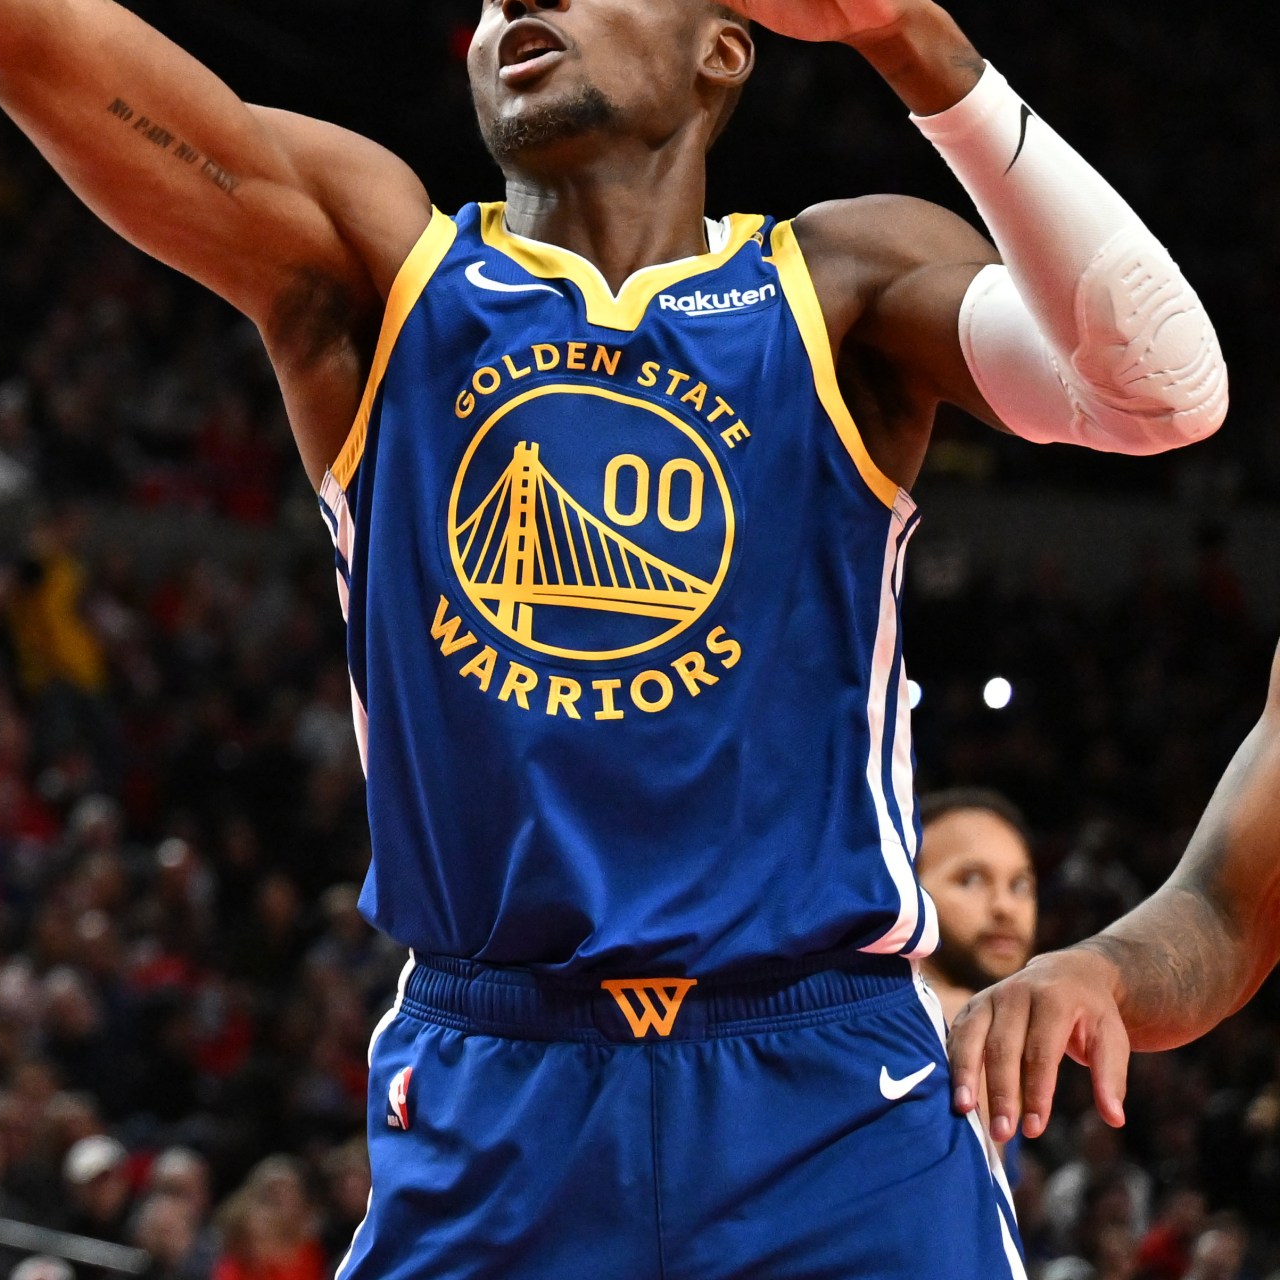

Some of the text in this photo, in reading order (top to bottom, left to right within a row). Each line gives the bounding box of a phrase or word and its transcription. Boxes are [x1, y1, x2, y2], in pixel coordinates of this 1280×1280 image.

[658, 283, 776, 314] Rakuten
[454, 341, 752, 451] GOLDEN STATE
[603, 452, 705, 533] 00
[430, 593, 743, 722] WARRIORS
